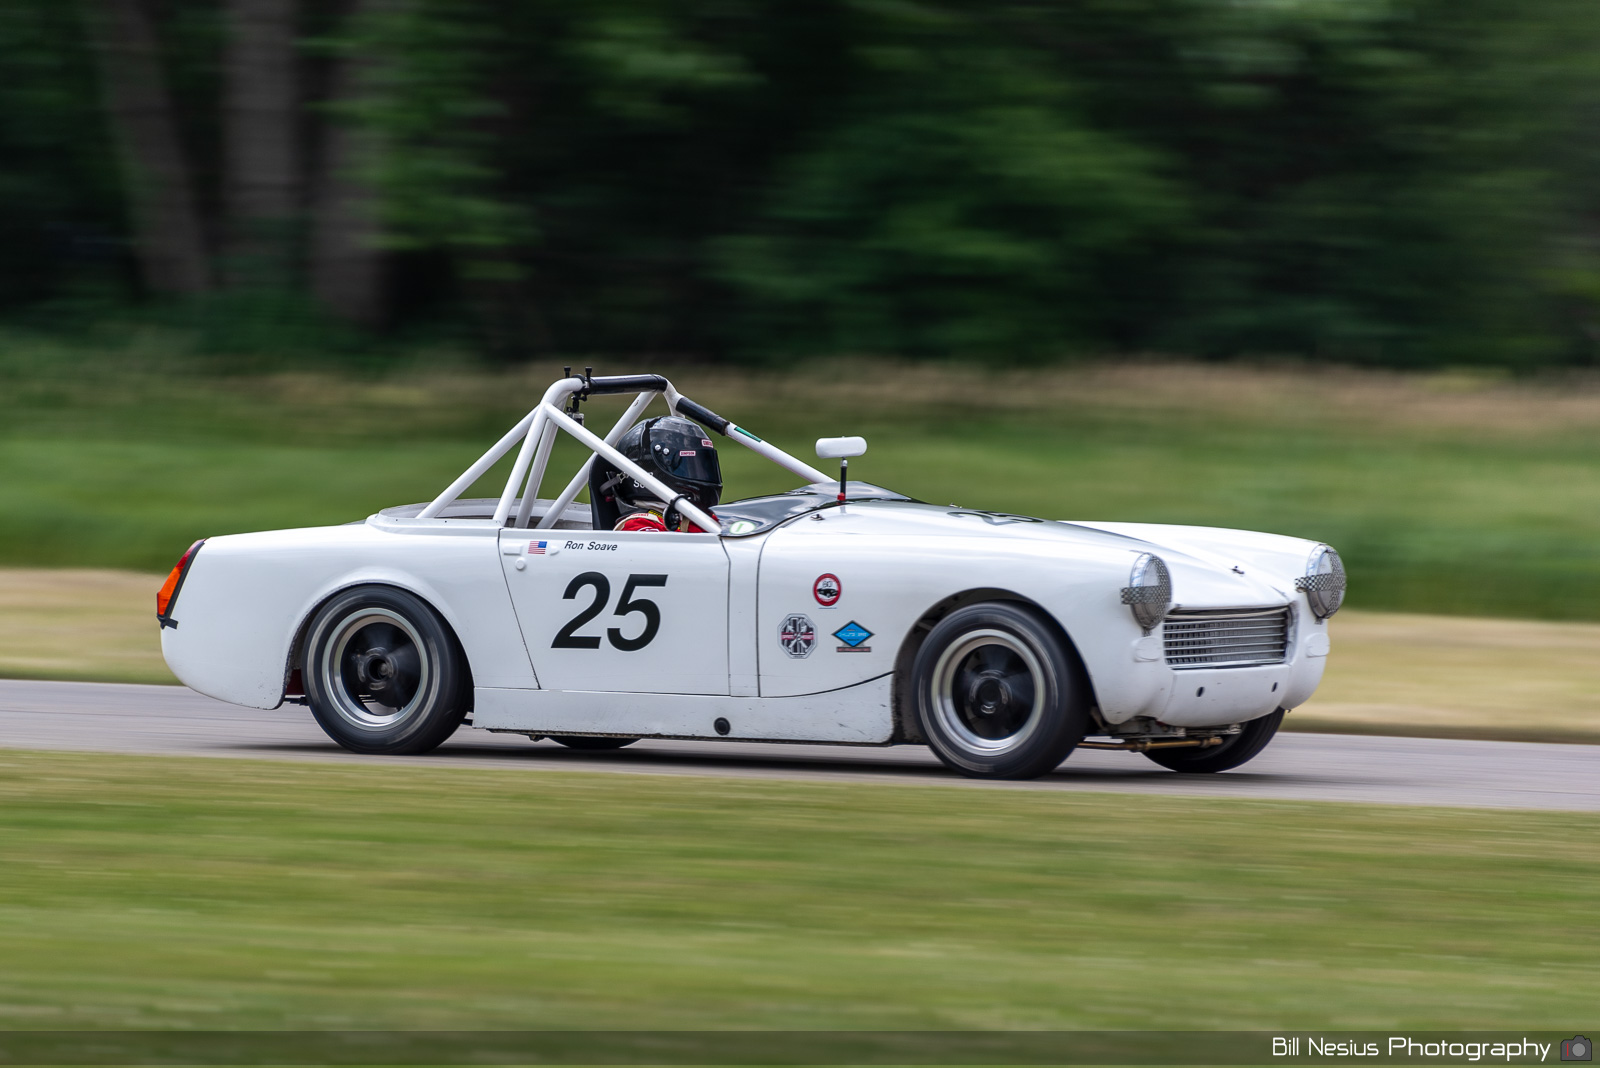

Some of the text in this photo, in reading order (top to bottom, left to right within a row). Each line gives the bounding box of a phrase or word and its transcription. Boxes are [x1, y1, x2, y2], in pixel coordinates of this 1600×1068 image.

[564, 540, 618, 551] Ron Soave
[550, 571, 668, 652] 25
